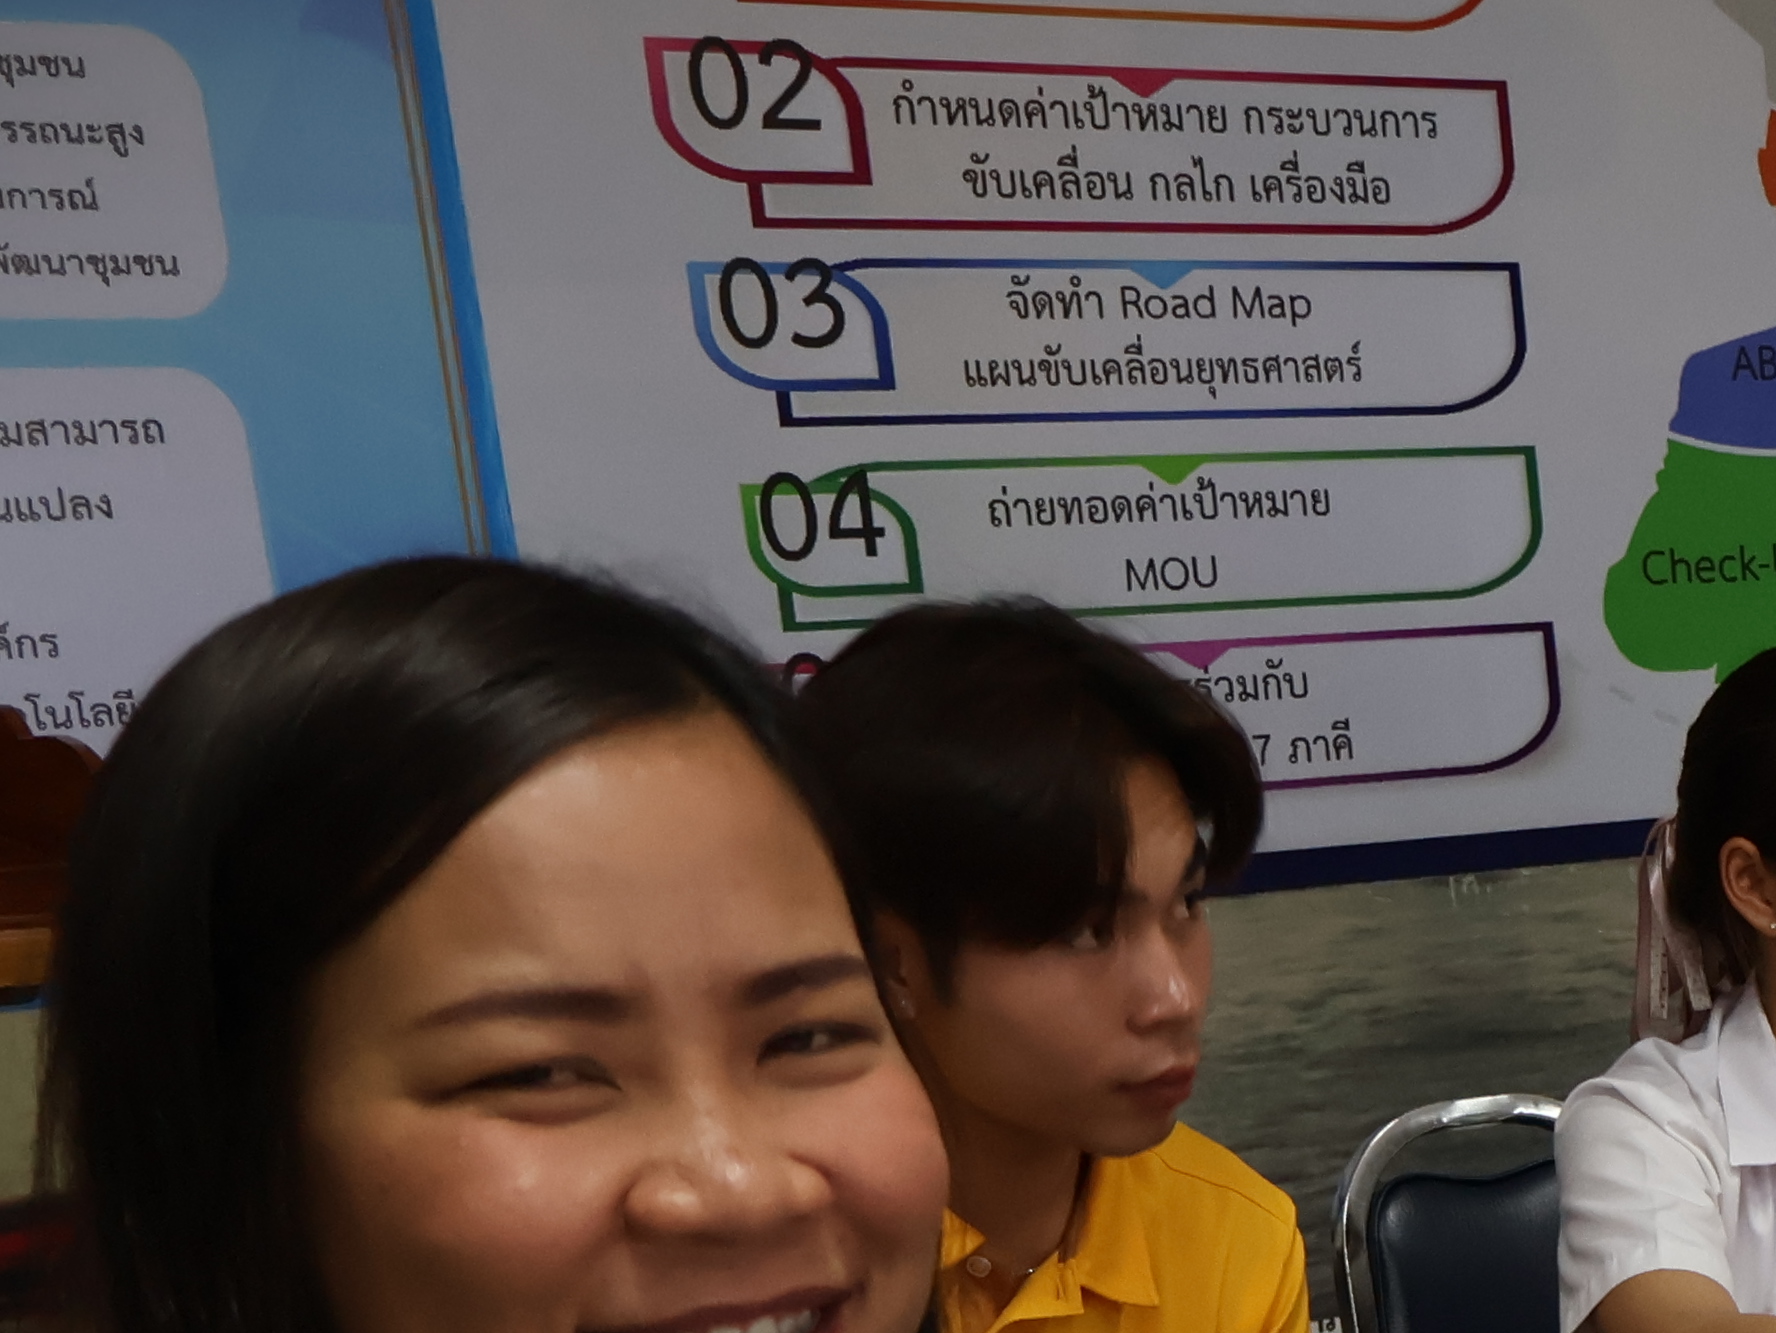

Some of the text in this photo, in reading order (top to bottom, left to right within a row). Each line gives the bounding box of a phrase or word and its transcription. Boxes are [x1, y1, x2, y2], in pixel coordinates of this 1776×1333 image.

[688, 35, 823, 131] 02
[892, 82, 1439, 140] กำหนดค่าเป้าหมาย กระบวนการ
[964, 146, 1392, 205] ขับเคลื่อน กลไก เครื่องมือ
[719, 256, 847, 349] 03
[1006, 274, 1313, 327] จัดทำ Road Map
[963, 333, 1363, 399] แผนขับเคลื่อนยุทธศาสตร์
[758, 469, 885, 562] 04
[987, 475, 1332, 527] ถ่ายทอดค่าเป้าหมาย
[1125, 554, 1219, 592] MOU
[1288, 717, 1355, 765] ภาคี
